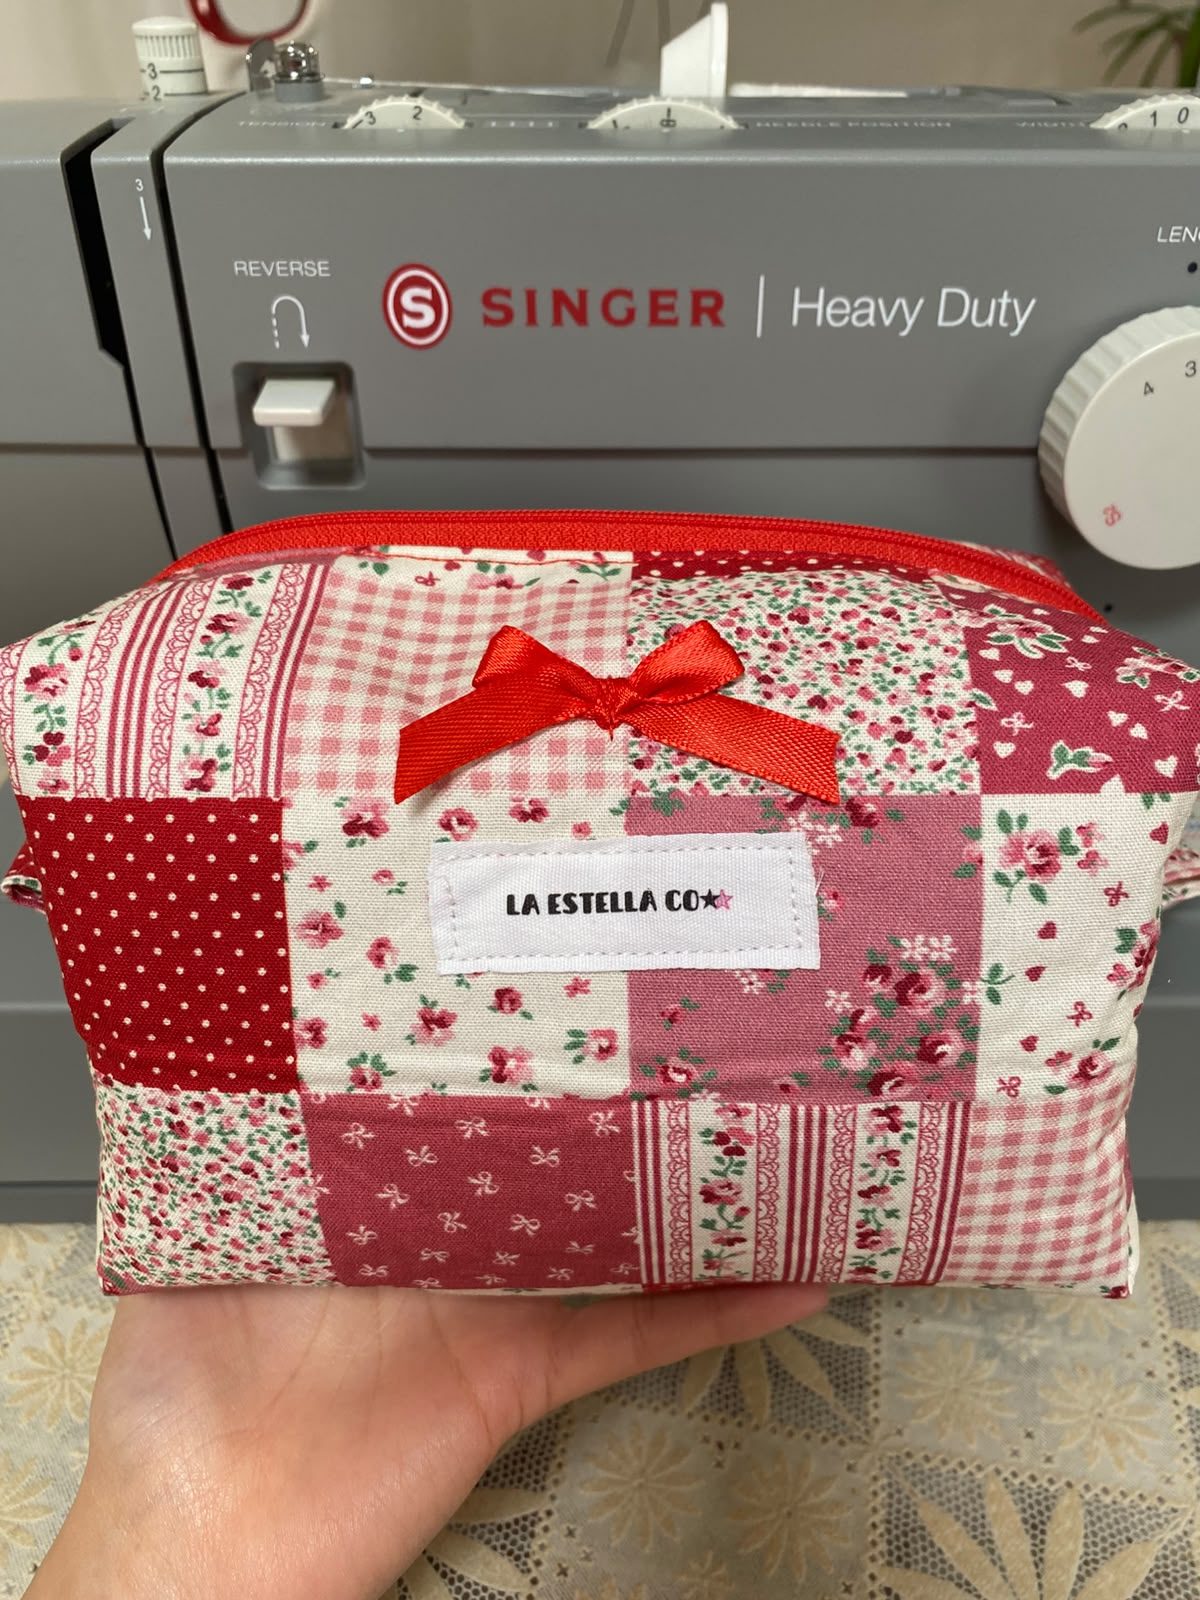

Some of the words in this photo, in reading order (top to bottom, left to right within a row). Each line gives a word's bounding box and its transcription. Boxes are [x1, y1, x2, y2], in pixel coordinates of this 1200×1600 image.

[146, 62, 158, 80] 3
[151, 85, 162, 101] 2
[365, 111, 376, 126] 3
[413, 105, 423, 121] 2
[1150, 110, 1158, 128] 1
[1177, 107, 1190, 125] 0
[135, 178, 144, 192] 3
[1157, 225, 1200, 243] LEN
[233, 260, 331, 277] REVERSE
[480, 287, 726, 328] SINGER
[791, 286, 925, 337] Heavy
[937, 287, 1037, 337] Duty
[1185, 360, 1197, 378] 3
[1143, 381, 1155, 397] 4
[506, 894, 540, 916] LA
[548, 890, 658, 915] ESTELLA
[664, 888, 700, 912] CO
